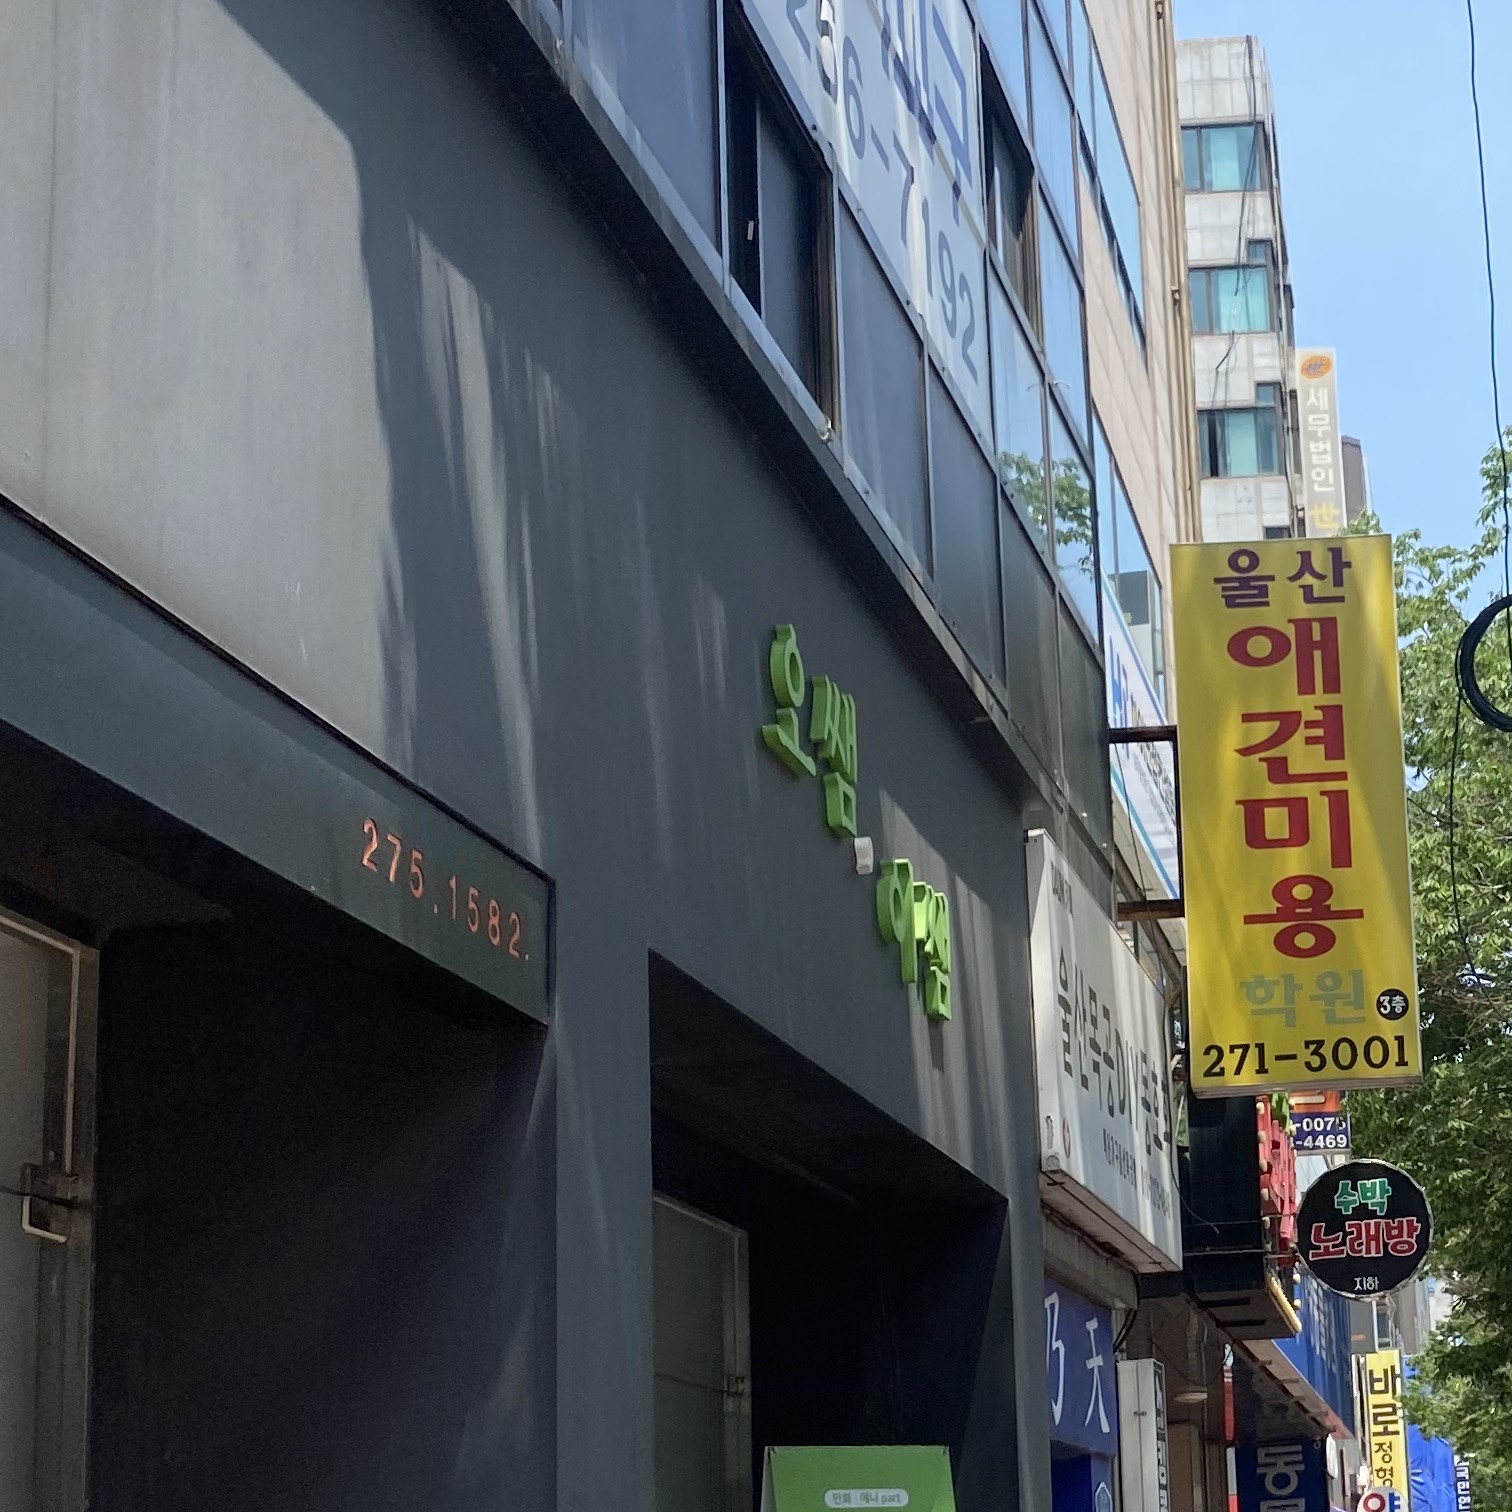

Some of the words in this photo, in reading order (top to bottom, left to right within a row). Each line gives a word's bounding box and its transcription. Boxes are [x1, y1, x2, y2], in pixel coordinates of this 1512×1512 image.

[1306, 386, 1335, 493] 세무법인
[1213, 546, 1352, 609] 울산
[1226, 615, 1365, 960] 애견미용
[1240, 968, 1367, 1029] 학원
[1380, 993, 1407, 1017] 3층
[1203, 1034, 1409, 1078] 271-3001
[1334, 1178, 1392, 1215] 수박
[1309, 1217, 1421, 1261] 노래방
[1353, 1276, 1379, 1291] 지하
[1369, 1365, 1400, 1437] 바로
